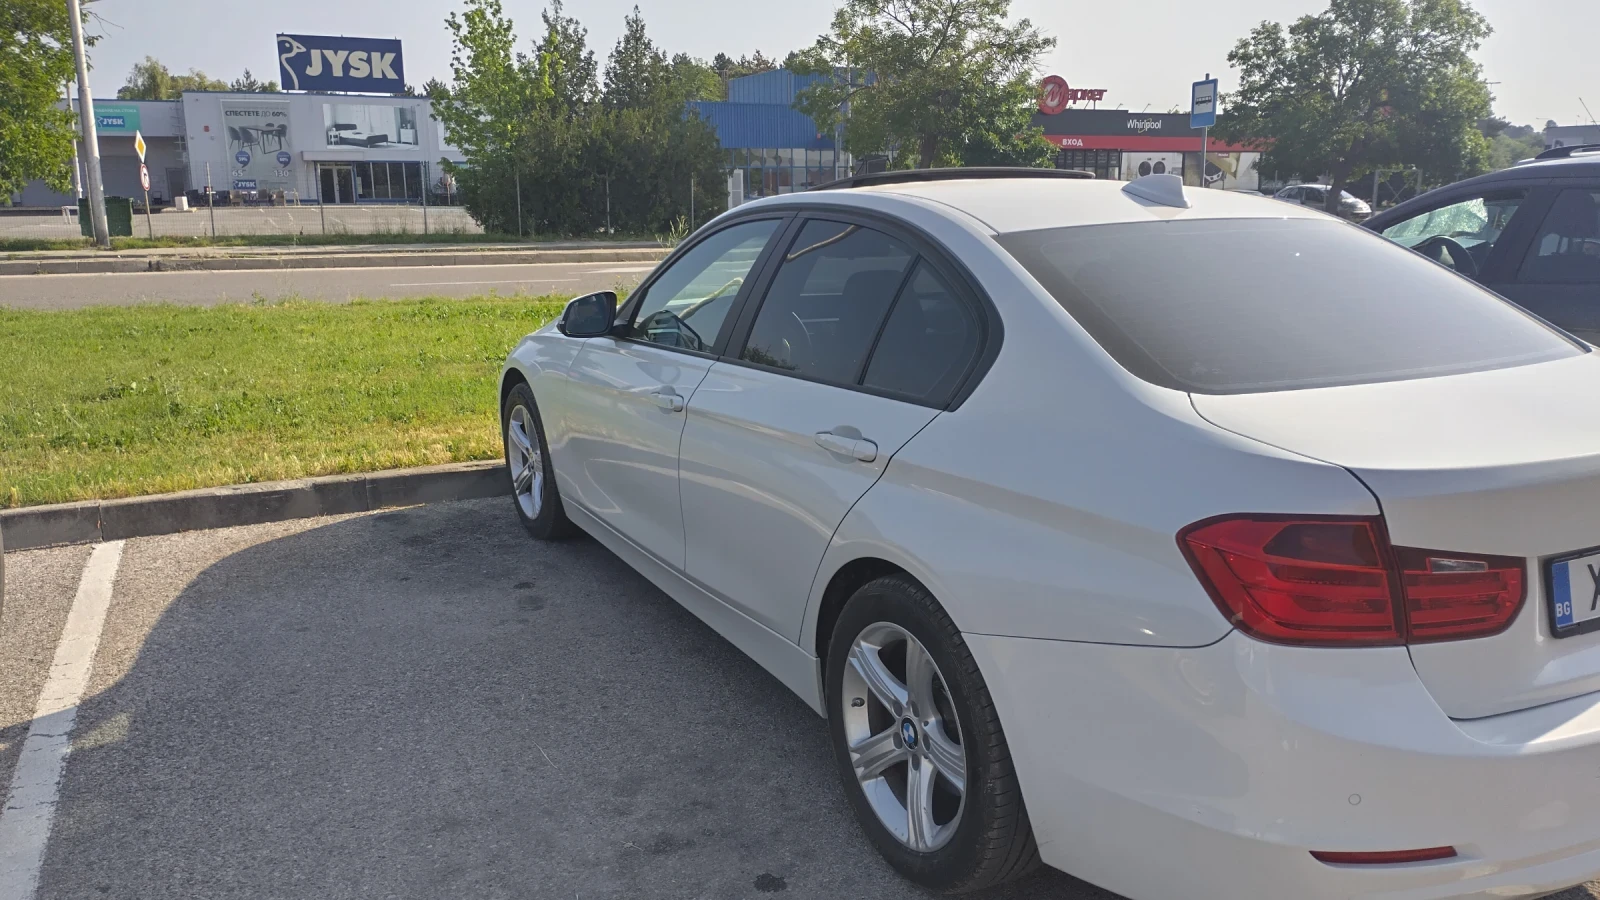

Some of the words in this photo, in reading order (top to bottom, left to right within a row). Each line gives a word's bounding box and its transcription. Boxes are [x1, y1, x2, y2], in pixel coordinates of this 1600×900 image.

[305, 49, 399, 79] JYSK
[261, 110, 271, 118] ДО
[1127, 119, 1162, 131] Whirlpool
[1062, 138, 1083, 147] ВХОД
[232, 169, 244, 177] 65
[274, 169, 289, 177] 130
[1556, 601, 1571, 617] BG
